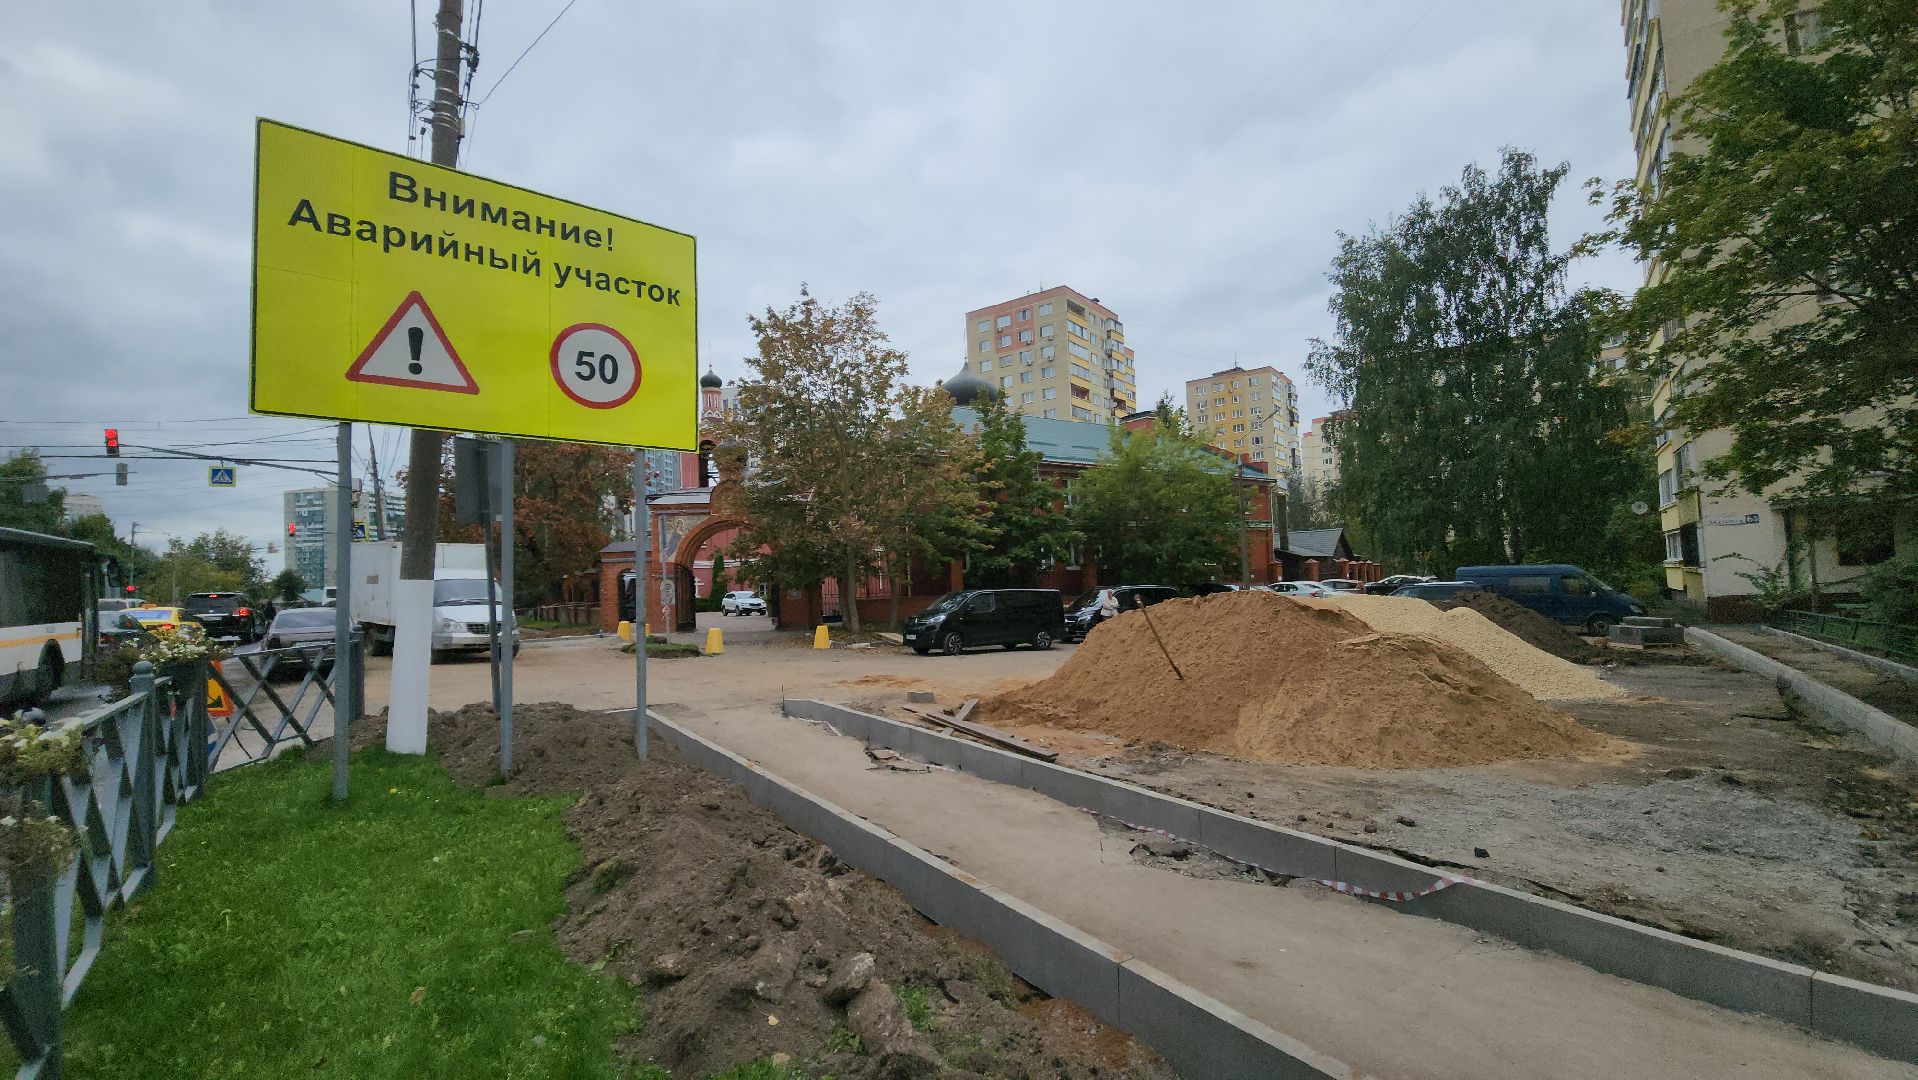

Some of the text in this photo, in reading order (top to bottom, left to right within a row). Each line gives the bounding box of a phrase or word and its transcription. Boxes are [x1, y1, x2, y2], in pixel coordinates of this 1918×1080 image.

[287, 198, 681, 307] Аварийный участок
[388, 170, 613, 253] Внимание!
[574, 350, 619, 386] 50
